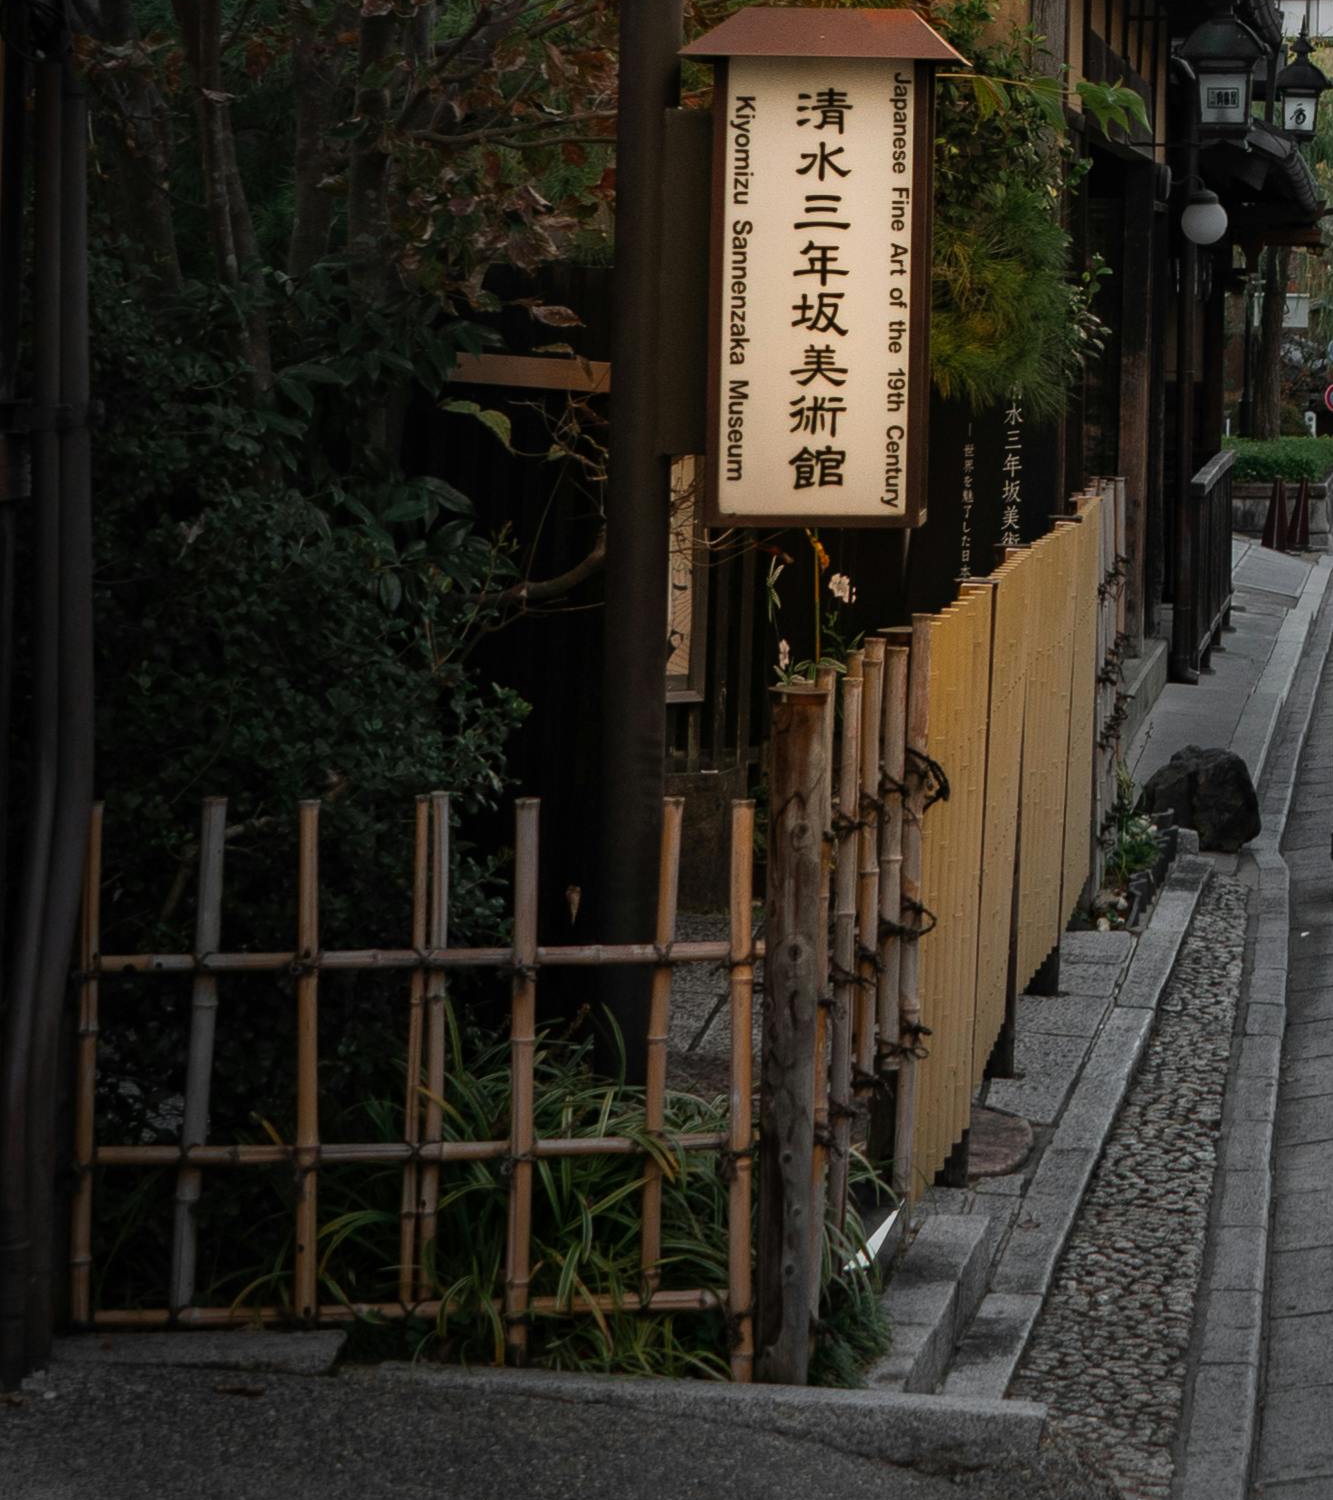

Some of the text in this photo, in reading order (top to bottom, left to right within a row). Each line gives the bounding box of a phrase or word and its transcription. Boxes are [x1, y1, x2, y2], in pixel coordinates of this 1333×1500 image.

[726, 96, 756, 482] Kiyomizu Sannenzaka Museum
[788, 87, 853, 490] 清水三年坂美術館
[880, 72, 912, 508] Japanese Fine Art of the 19th Century
